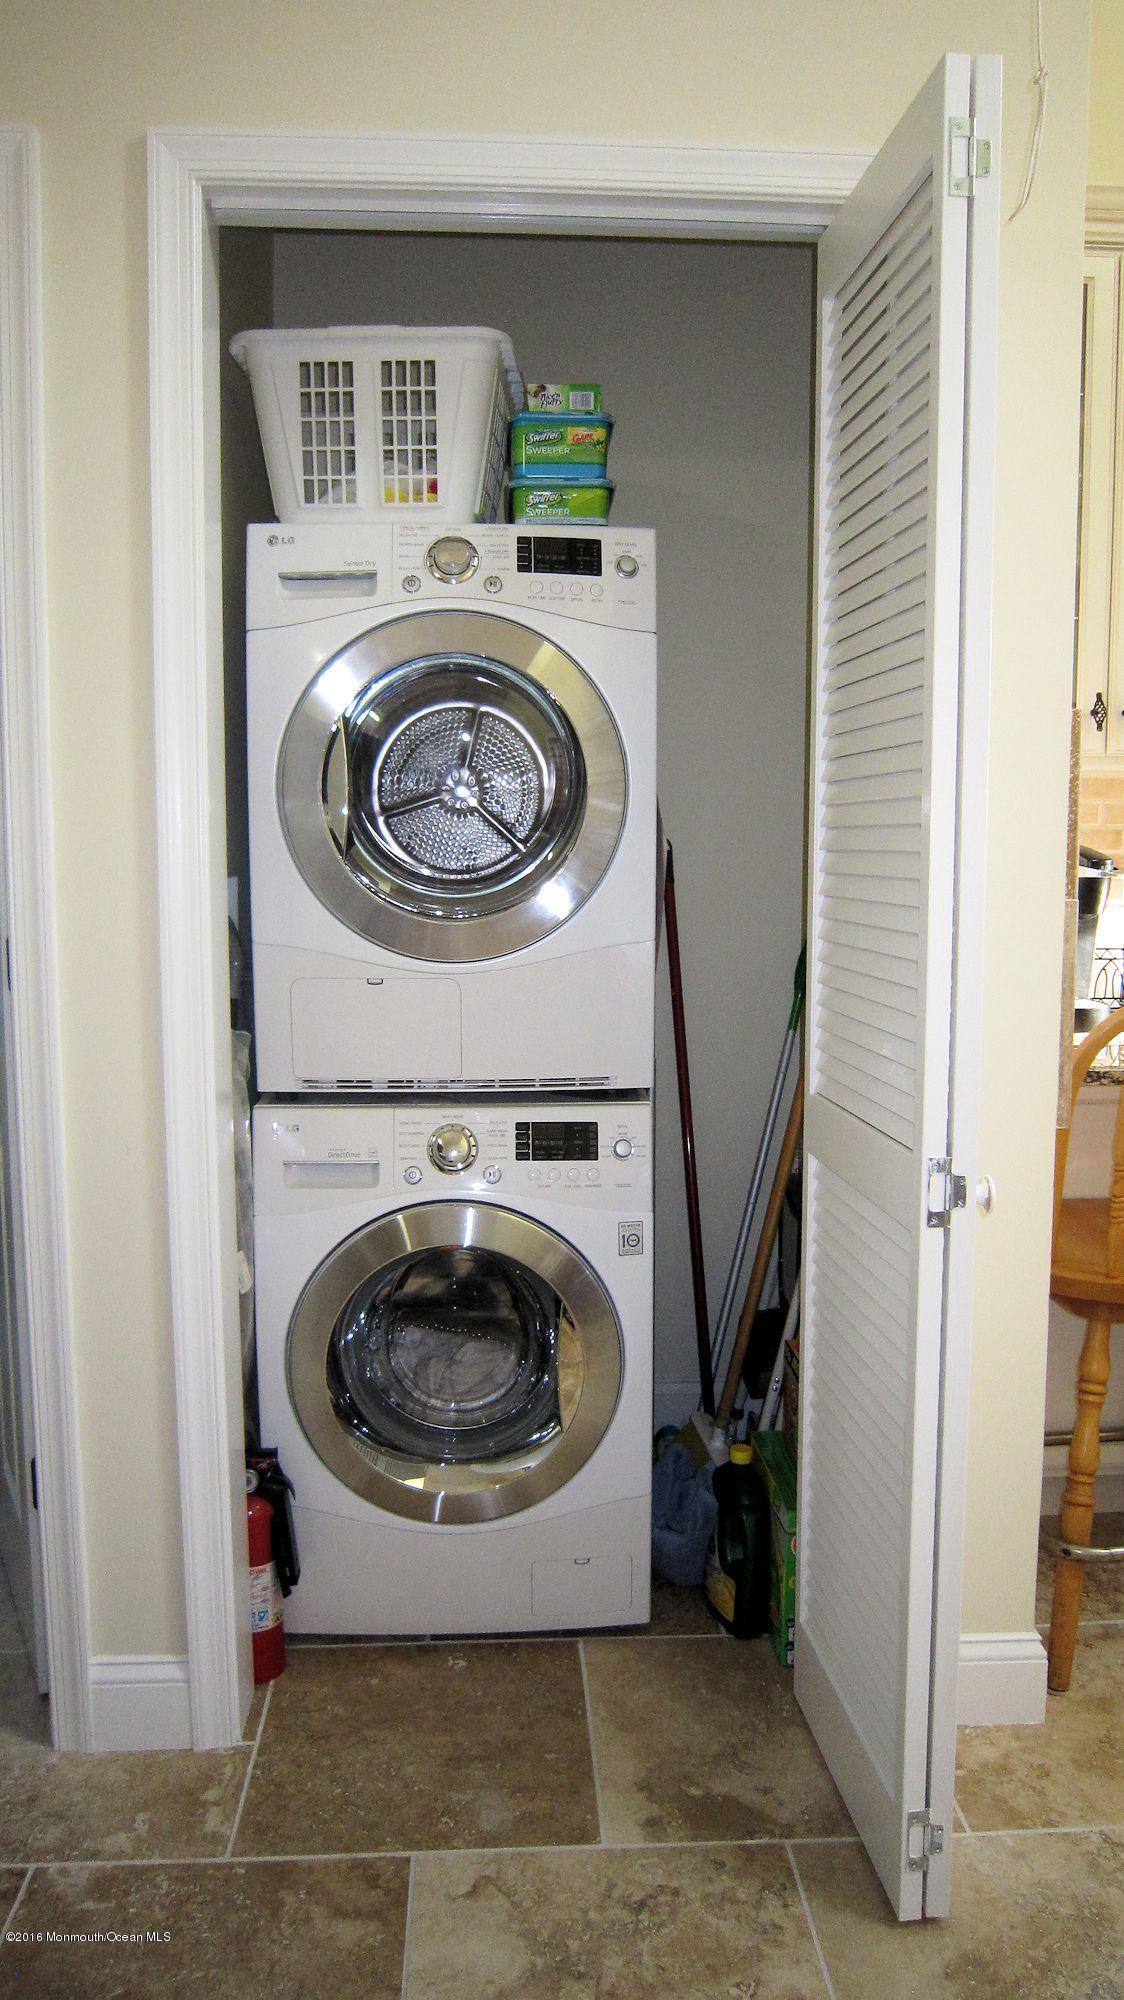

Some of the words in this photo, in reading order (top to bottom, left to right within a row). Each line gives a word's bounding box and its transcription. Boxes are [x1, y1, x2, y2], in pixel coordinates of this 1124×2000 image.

[526, 431, 562, 444] Swiffer
[526, 446, 571, 455] SWEEPER
[526, 493, 562, 506] Swiffer
[526, 507, 570, 516] SWEEPER
[281, 537, 296, 545] LG
[622, 1233, 640, 1248] 10
